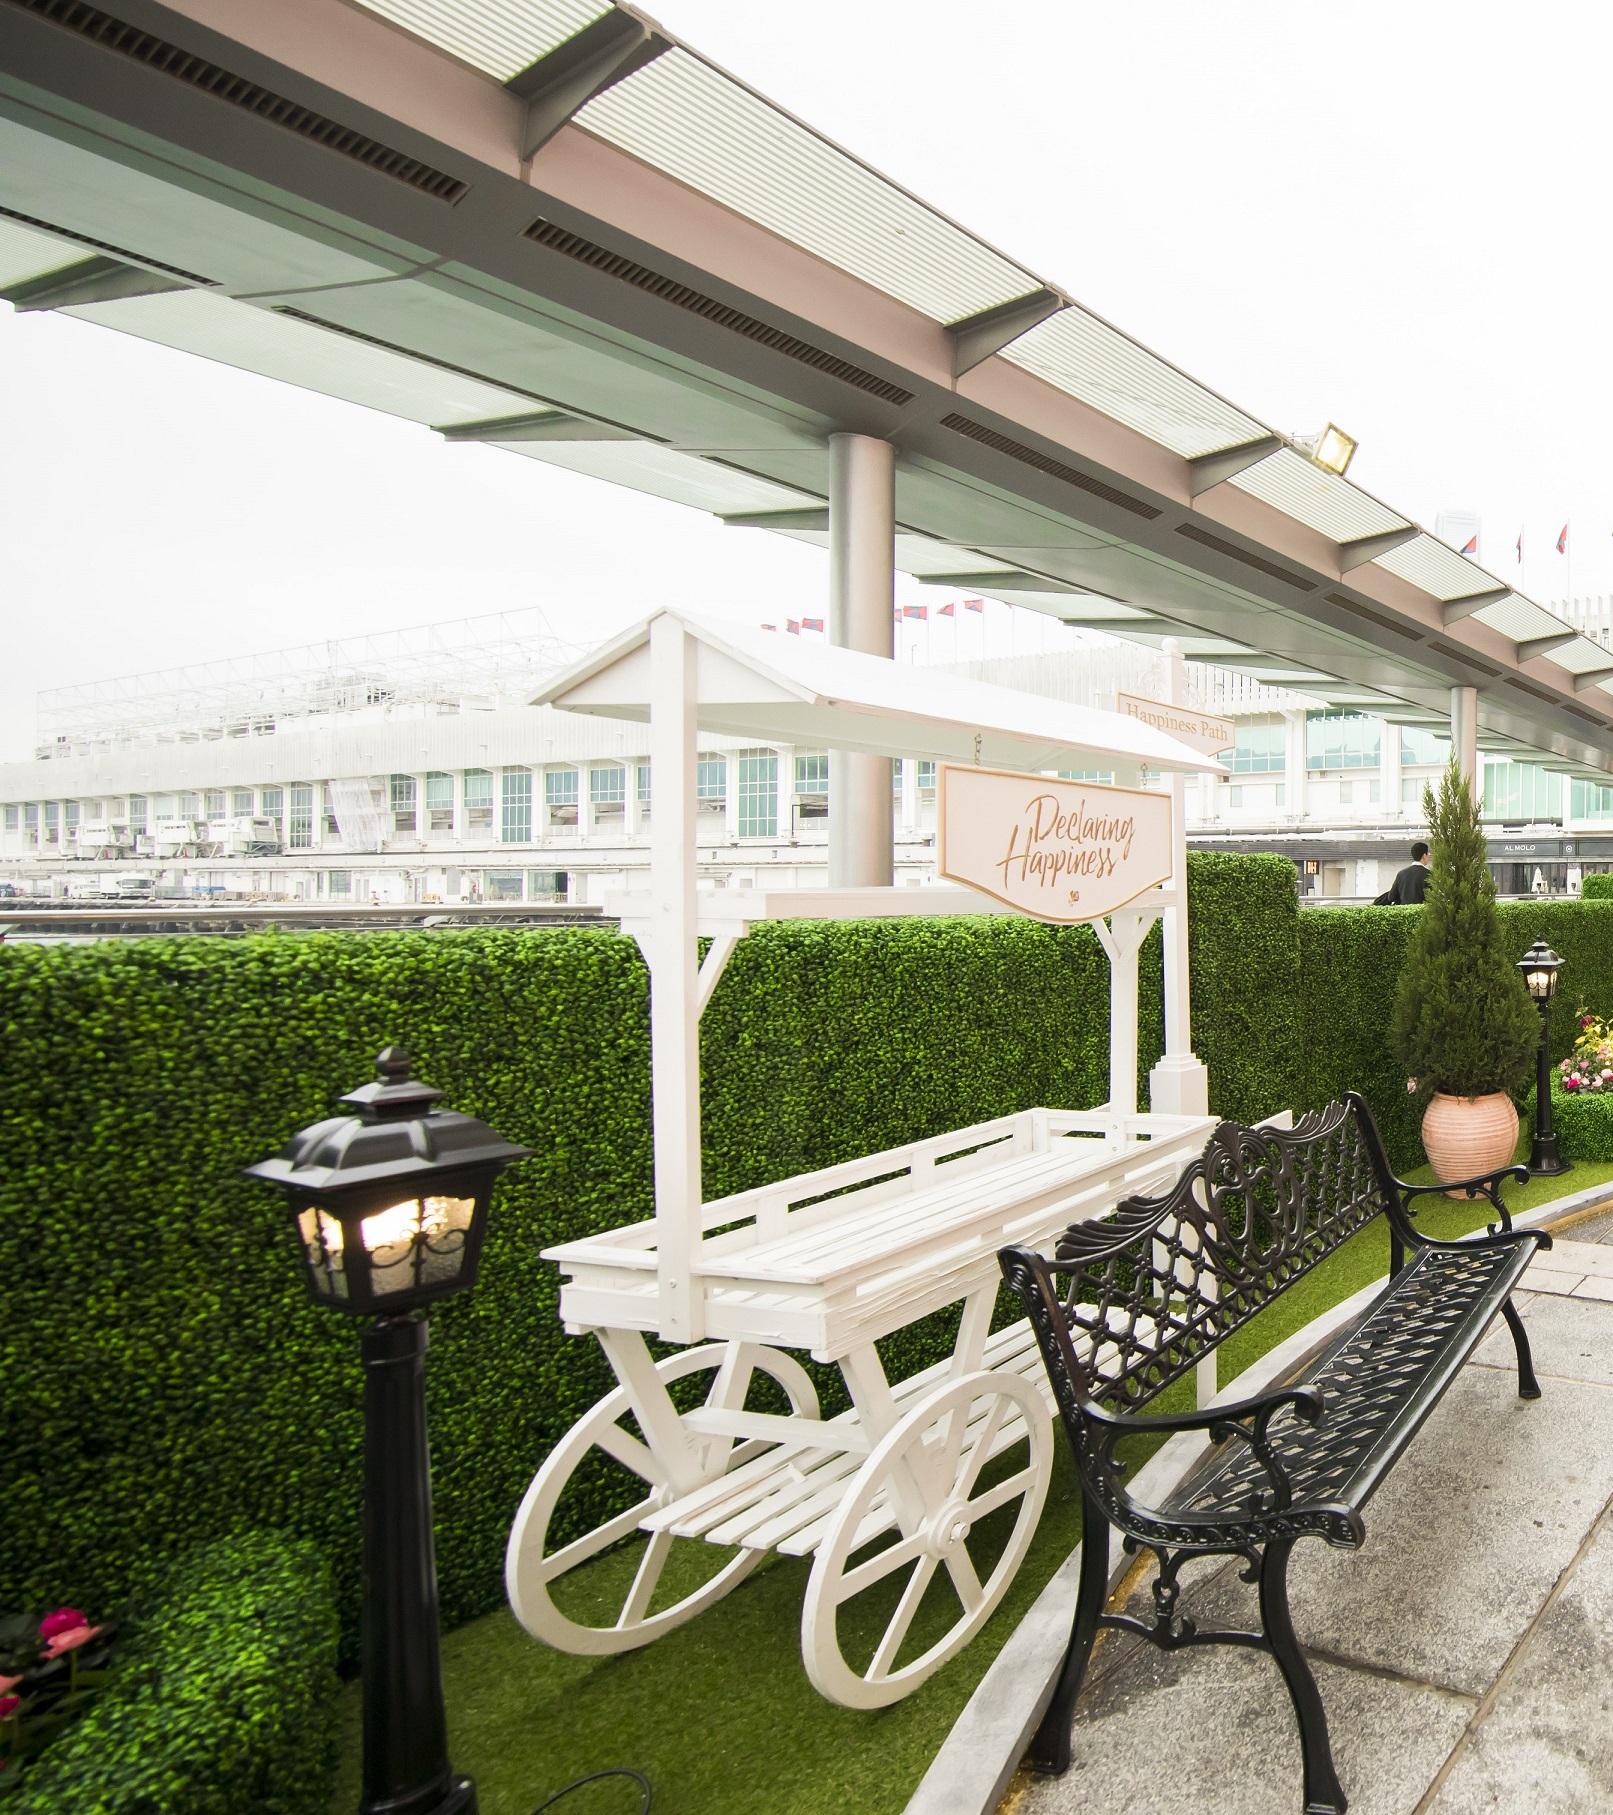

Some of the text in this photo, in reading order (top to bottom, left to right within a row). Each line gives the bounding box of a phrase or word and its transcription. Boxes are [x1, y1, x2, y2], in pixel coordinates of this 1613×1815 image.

[1126, 703, 1229, 742] Happiness Path
[995, 824, 1119, 889] Happiness
[1025, 794, 1135, 859] Declaring
